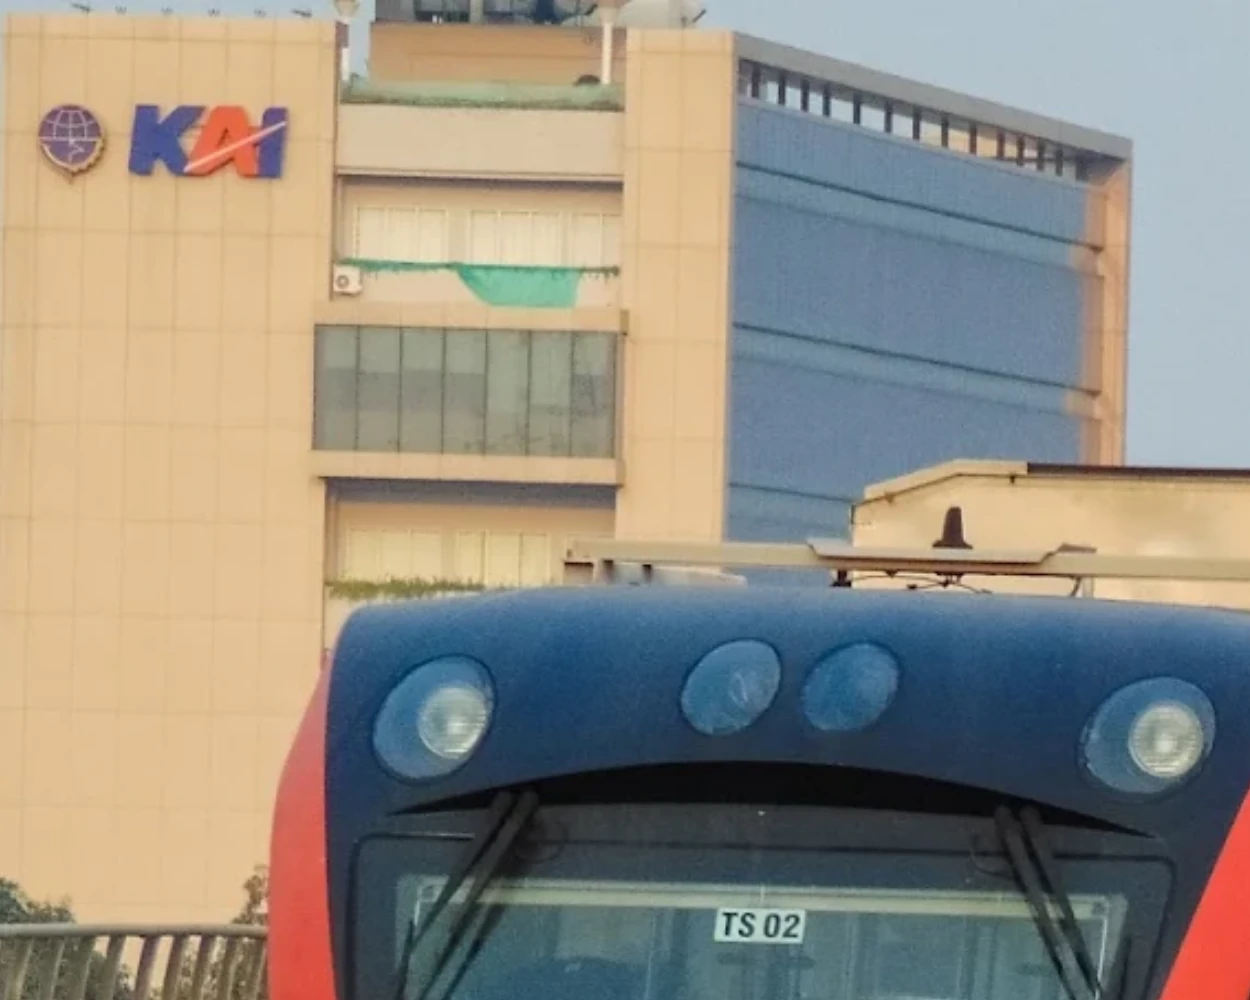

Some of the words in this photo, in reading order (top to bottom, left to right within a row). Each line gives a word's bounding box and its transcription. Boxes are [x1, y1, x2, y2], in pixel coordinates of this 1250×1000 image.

[128, 105, 288, 178] KAI
[722, 912, 756, 938] TS
[763, 913, 800, 938] 02
